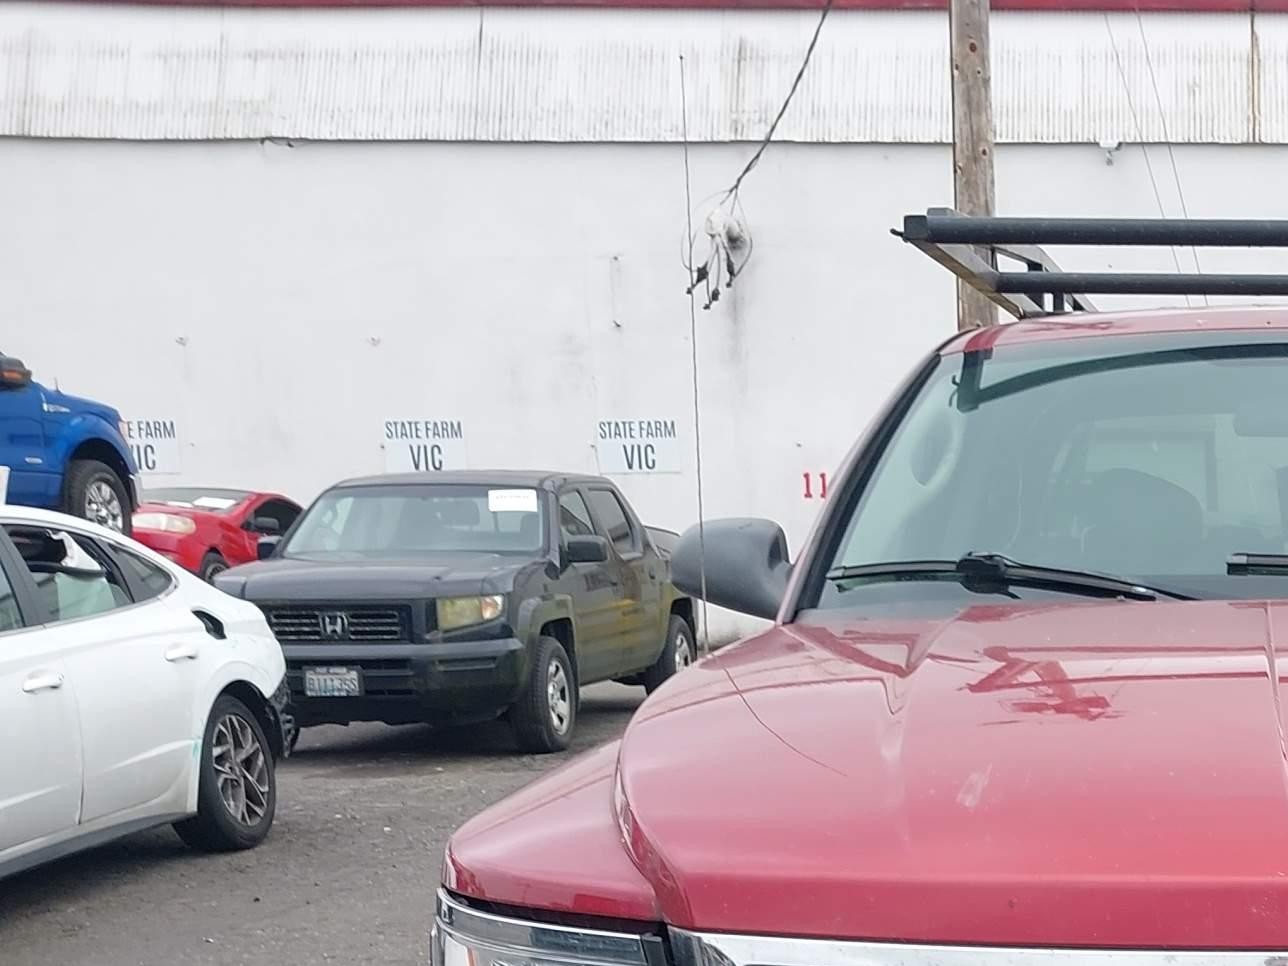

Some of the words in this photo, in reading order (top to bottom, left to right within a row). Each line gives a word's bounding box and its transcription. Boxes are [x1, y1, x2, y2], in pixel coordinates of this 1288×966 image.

[137, 420, 176, 439] FARM
[385, 420, 422, 439] STATE
[425, 420, 463, 439] FARM
[599, 420, 635, 439] STATE
[639, 420, 676, 438] FARM
[130, 443, 156, 471] IC
[409, 443, 443, 471] VIC
[622, 443, 656, 470] VIC
[803, 472, 827, 499] 11
